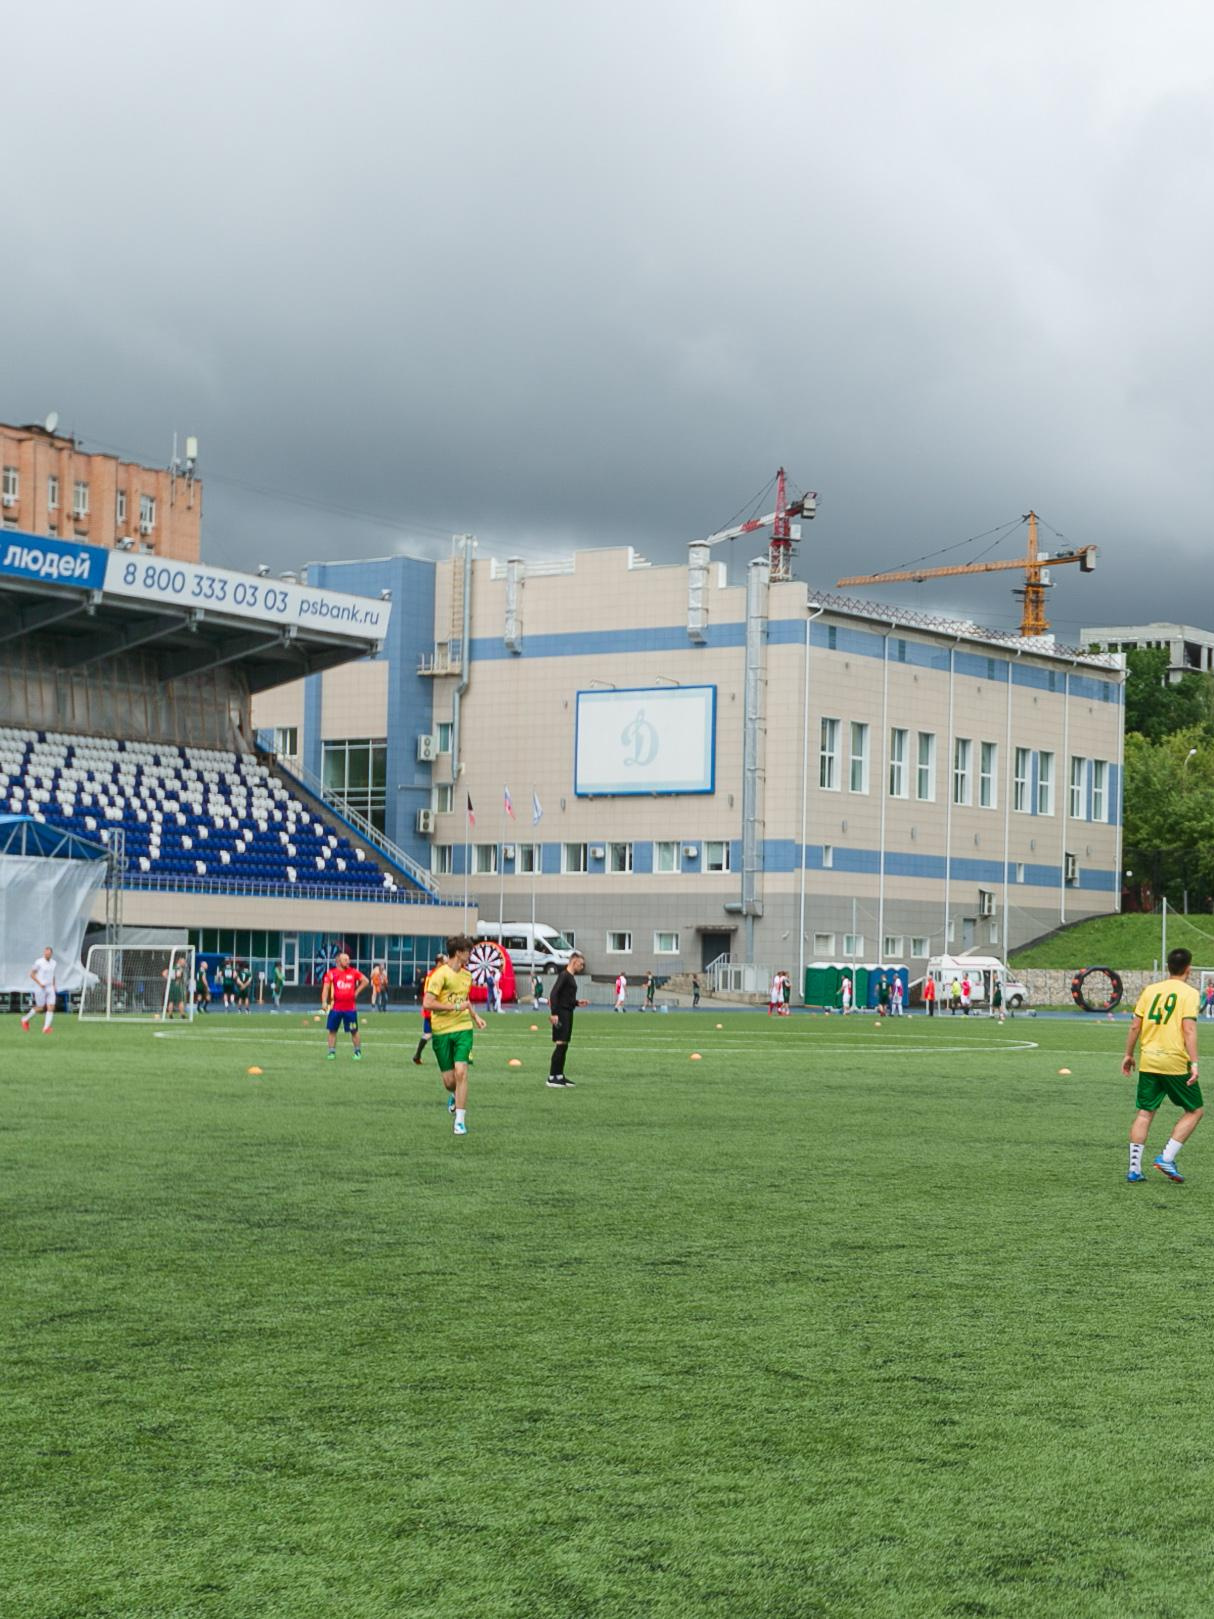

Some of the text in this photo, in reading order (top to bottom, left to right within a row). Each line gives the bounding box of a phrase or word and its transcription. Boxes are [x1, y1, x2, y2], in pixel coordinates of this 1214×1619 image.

[3, 544, 91, 579] людей
[123, 562, 380, 625] 8 800 333 03 03 psbank.ru
[1147, 992, 1178, 1025] 49
